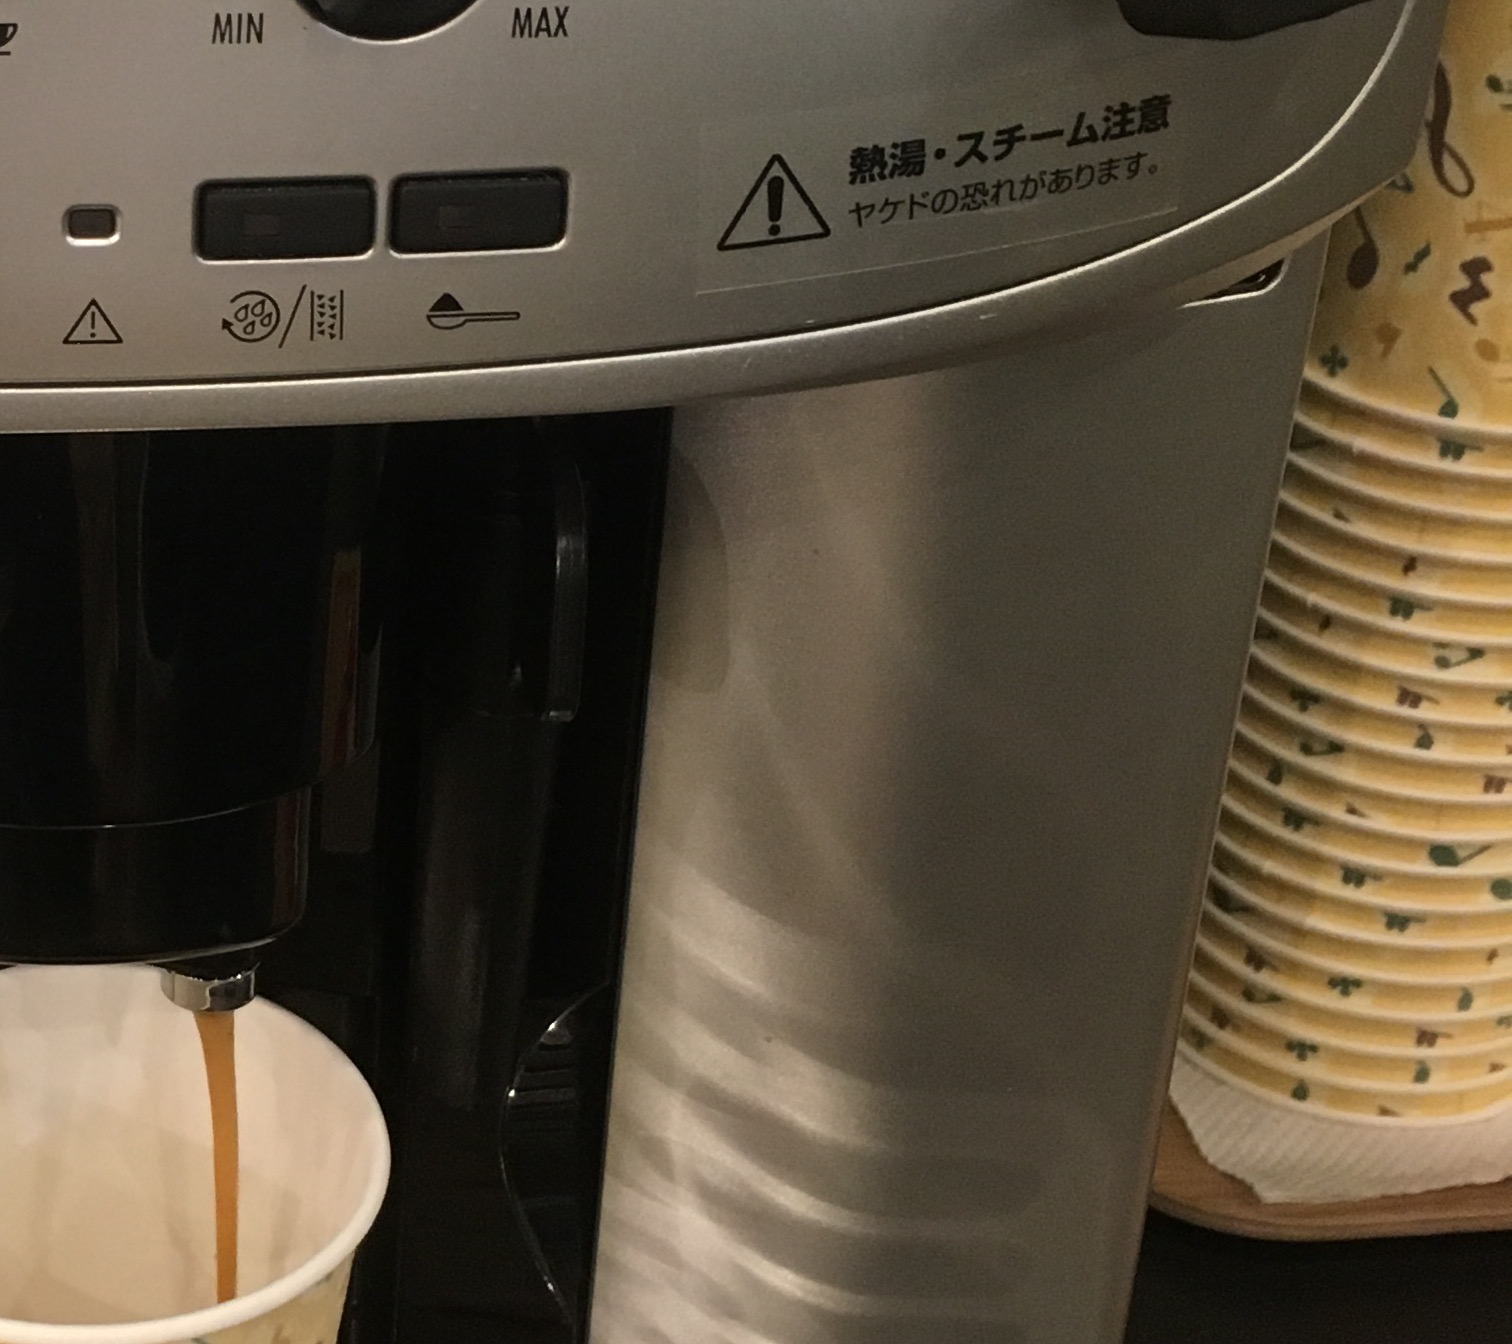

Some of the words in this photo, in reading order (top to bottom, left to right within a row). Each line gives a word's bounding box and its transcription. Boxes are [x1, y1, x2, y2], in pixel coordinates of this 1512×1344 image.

[211, 12, 264, 45] MIN
[511, 5, 571, 39] MAX
[848, 151, 1158, 228] ヤケドの恐れがあります。
